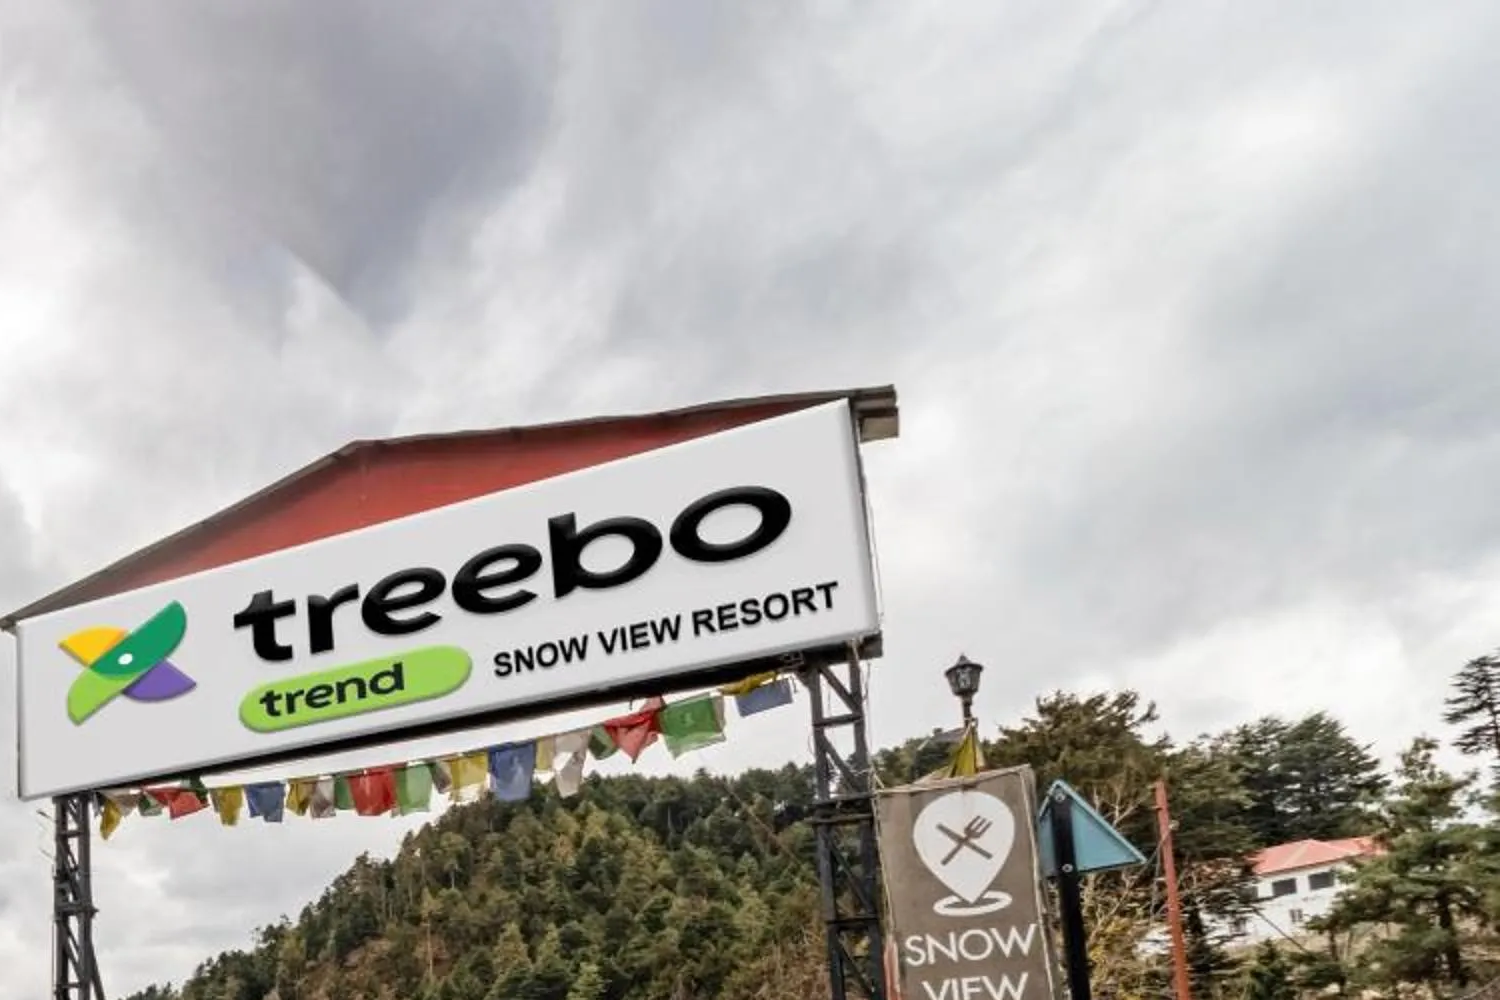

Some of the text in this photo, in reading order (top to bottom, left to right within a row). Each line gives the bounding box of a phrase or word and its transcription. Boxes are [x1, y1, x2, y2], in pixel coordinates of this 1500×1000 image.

[233, 485, 792, 663] treebo
[492, 581, 839, 678] SNOW VIEW RESORT
[259, 661, 405, 718] trend
[904, 923, 1038, 967] SNOW
